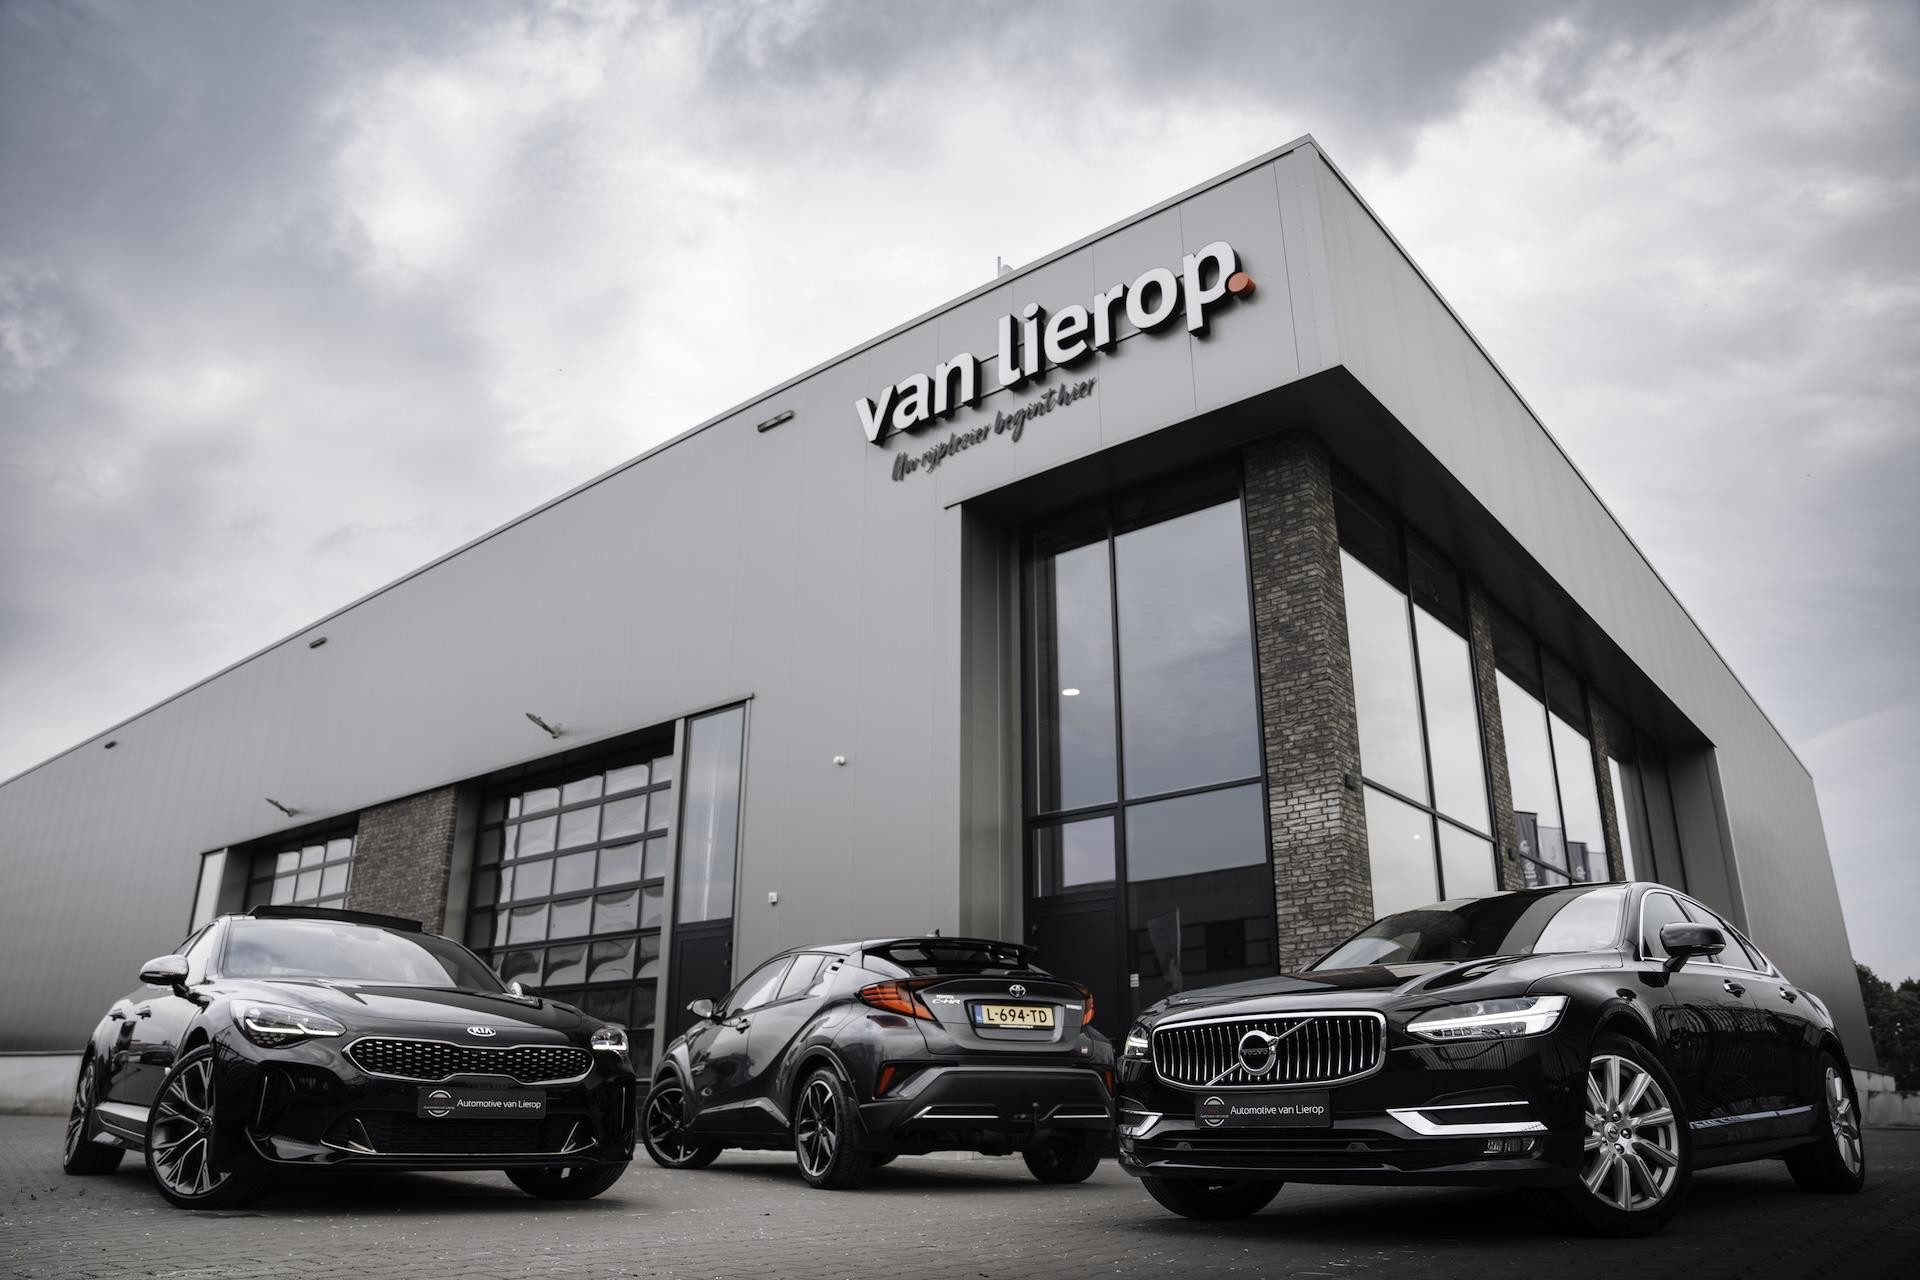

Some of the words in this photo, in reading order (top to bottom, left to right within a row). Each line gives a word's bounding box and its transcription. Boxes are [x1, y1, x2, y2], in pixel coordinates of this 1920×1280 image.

[855, 352, 977, 443] van
[994, 388, 1057, 442] begint
[1056, 377, 1096, 406] hier
[986, 1008, 1047, 1023] L-694-TD
[457, 1099, 502, 1108] Automotive
[518, 1100, 541, 1109] Lierop
[1230, 1105, 1277, 1115] Automotive
[1278, 1106, 1294, 1114] van
[1295, 1104, 1324, 1115] Lierop
